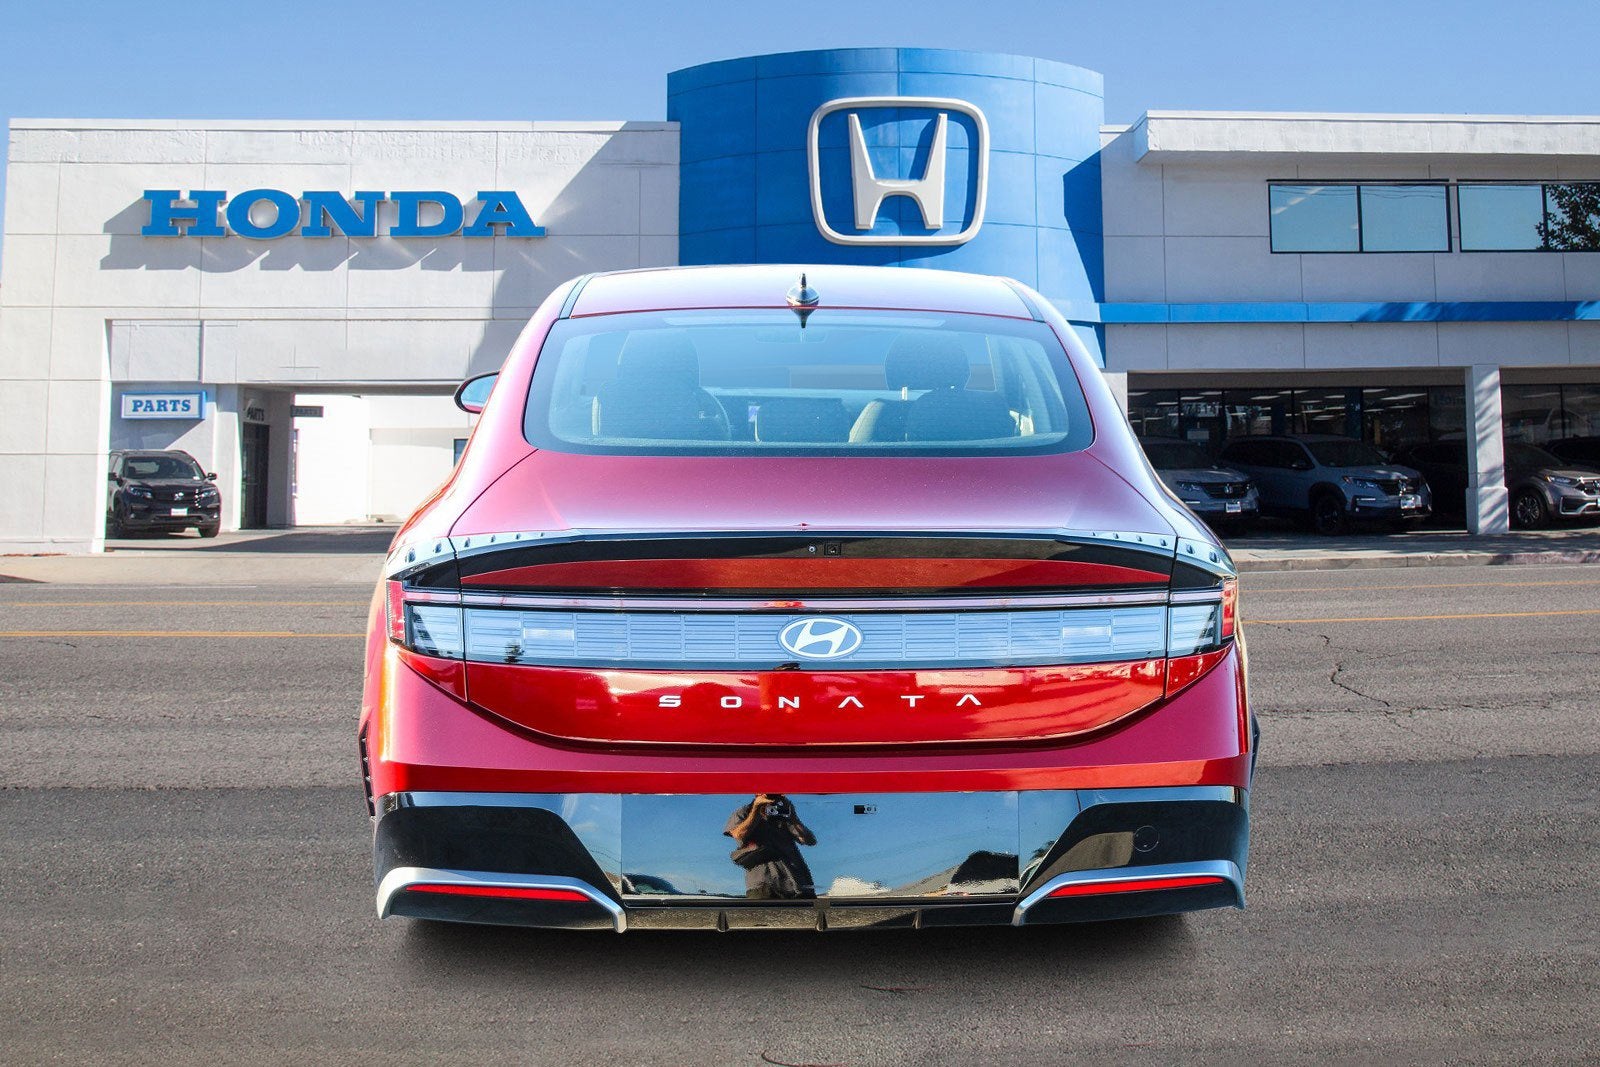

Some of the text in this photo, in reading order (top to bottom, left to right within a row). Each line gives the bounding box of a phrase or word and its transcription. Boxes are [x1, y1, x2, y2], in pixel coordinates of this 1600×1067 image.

[141, 188, 547, 239] HONDA
[132, 399, 191, 413] PARTS
[658, 694, 982, 709] SONATA
